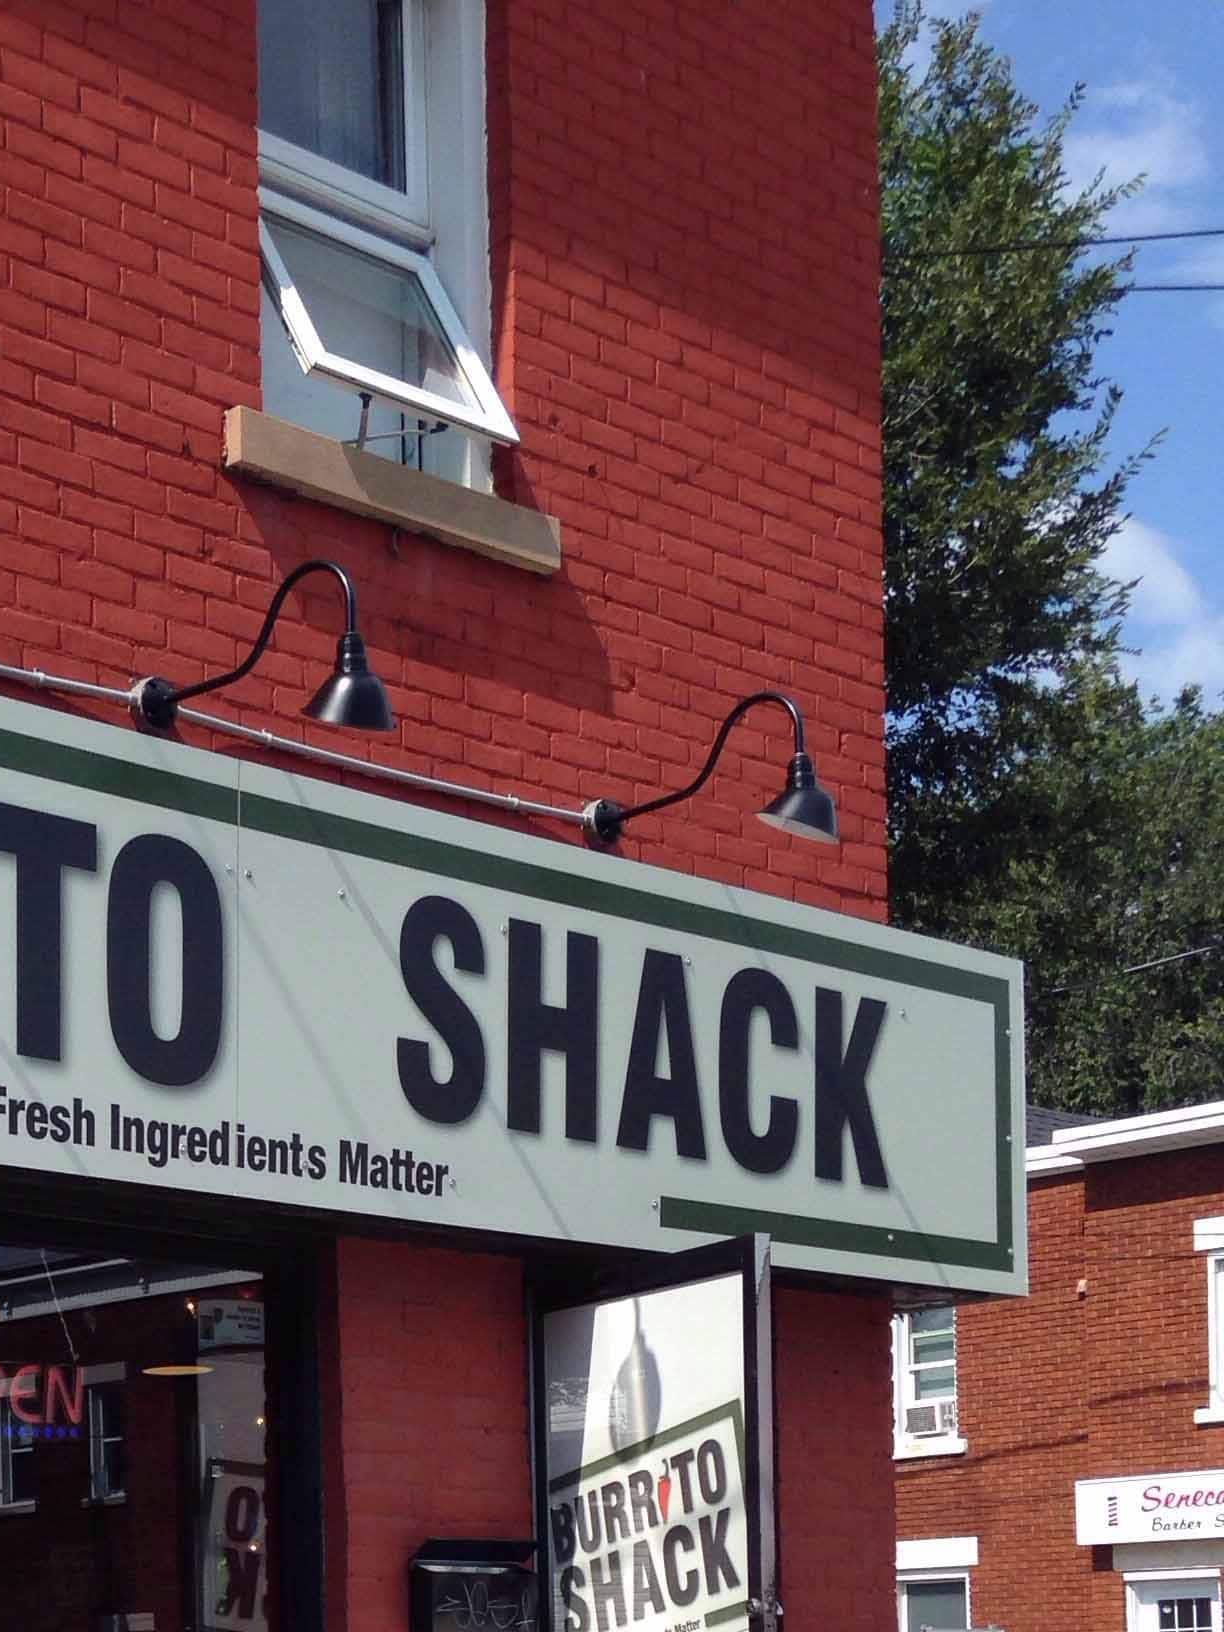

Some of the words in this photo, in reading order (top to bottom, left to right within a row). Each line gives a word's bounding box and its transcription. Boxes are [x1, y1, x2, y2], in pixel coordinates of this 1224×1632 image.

[395, 893, 888, 1189] SHACK
[110, 1103, 327, 1181] Ingredients
[338, 1139, 450, 1197] Matter
[550, 1439, 727, 1564] BURRITO
[1151, 1516, 1202, 1532] Barber
